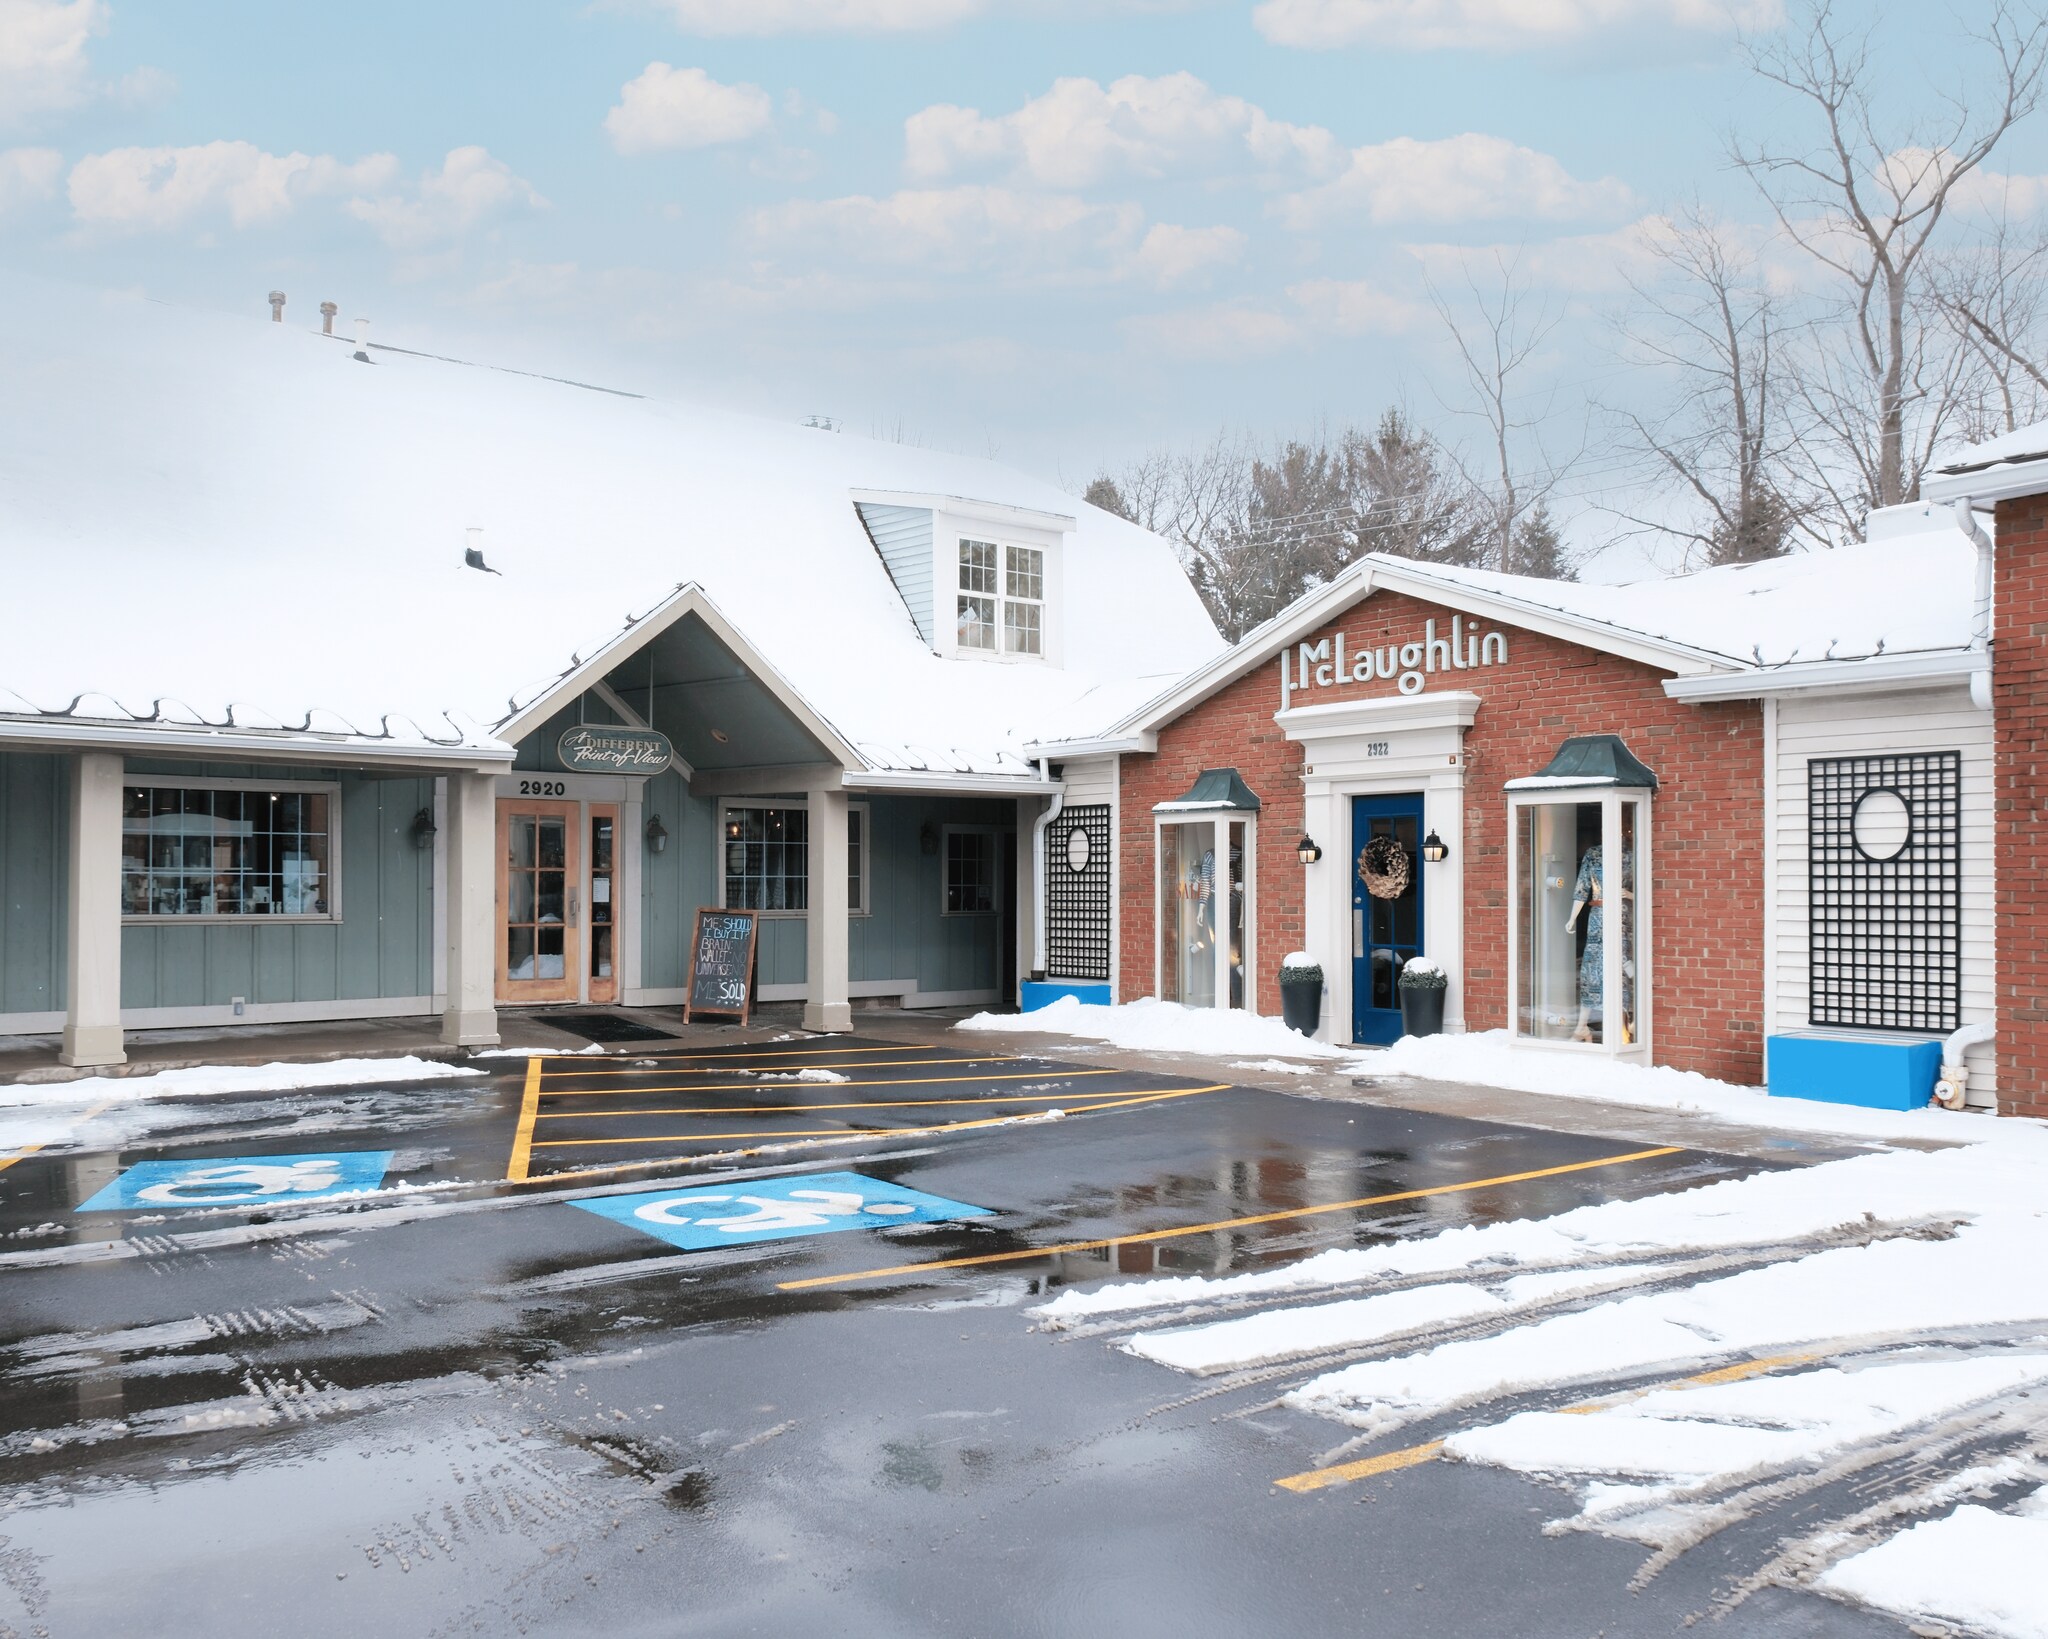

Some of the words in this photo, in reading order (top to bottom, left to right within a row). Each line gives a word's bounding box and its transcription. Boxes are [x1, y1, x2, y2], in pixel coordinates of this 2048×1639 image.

[565, 731, 591, 747] A
[586, 739, 661, 752] DIFFERENT
[574, 746, 615, 763] Point
[611, 748, 635, 767] of
[633, 748, 668, 765] View
[1367, 742, 1389, 757] 2922
[520, 780, 565, 796] 2920
[703, 917, 722, 929] ME:
[723, 918, 752, 931] SHOULD
[703, 928, 712, 938] I
[713, 928, 731, 939] BUY
[731, 930, 750, 940] IT?
[701, 938, 733, 951] BRAIN:
[700, 949, 731, 963] WALLET:
[732, 951, 747, 964] NO
[720, 982, 746, 1001] SOLD
